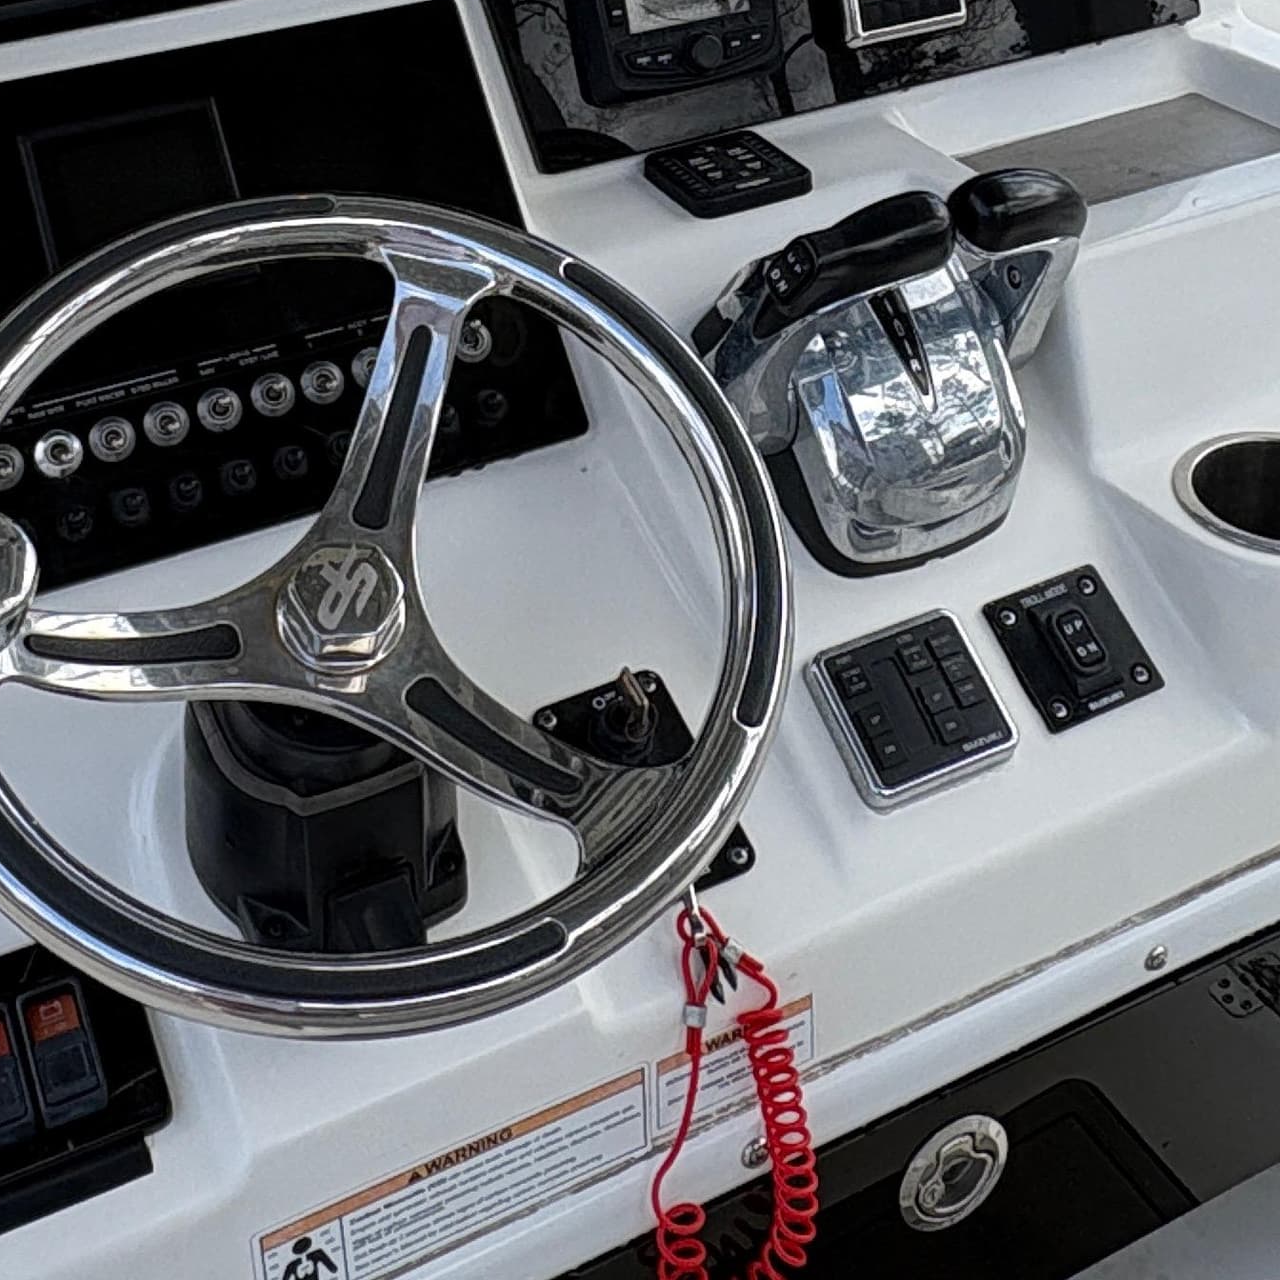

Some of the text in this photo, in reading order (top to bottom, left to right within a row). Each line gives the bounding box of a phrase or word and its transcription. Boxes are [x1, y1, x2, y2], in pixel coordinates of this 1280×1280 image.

[1063, 619, 1083, 635] UP
[962, 731, 1003, 752] SUZUKI
[425, 1127, 513, 1171] WARNING
